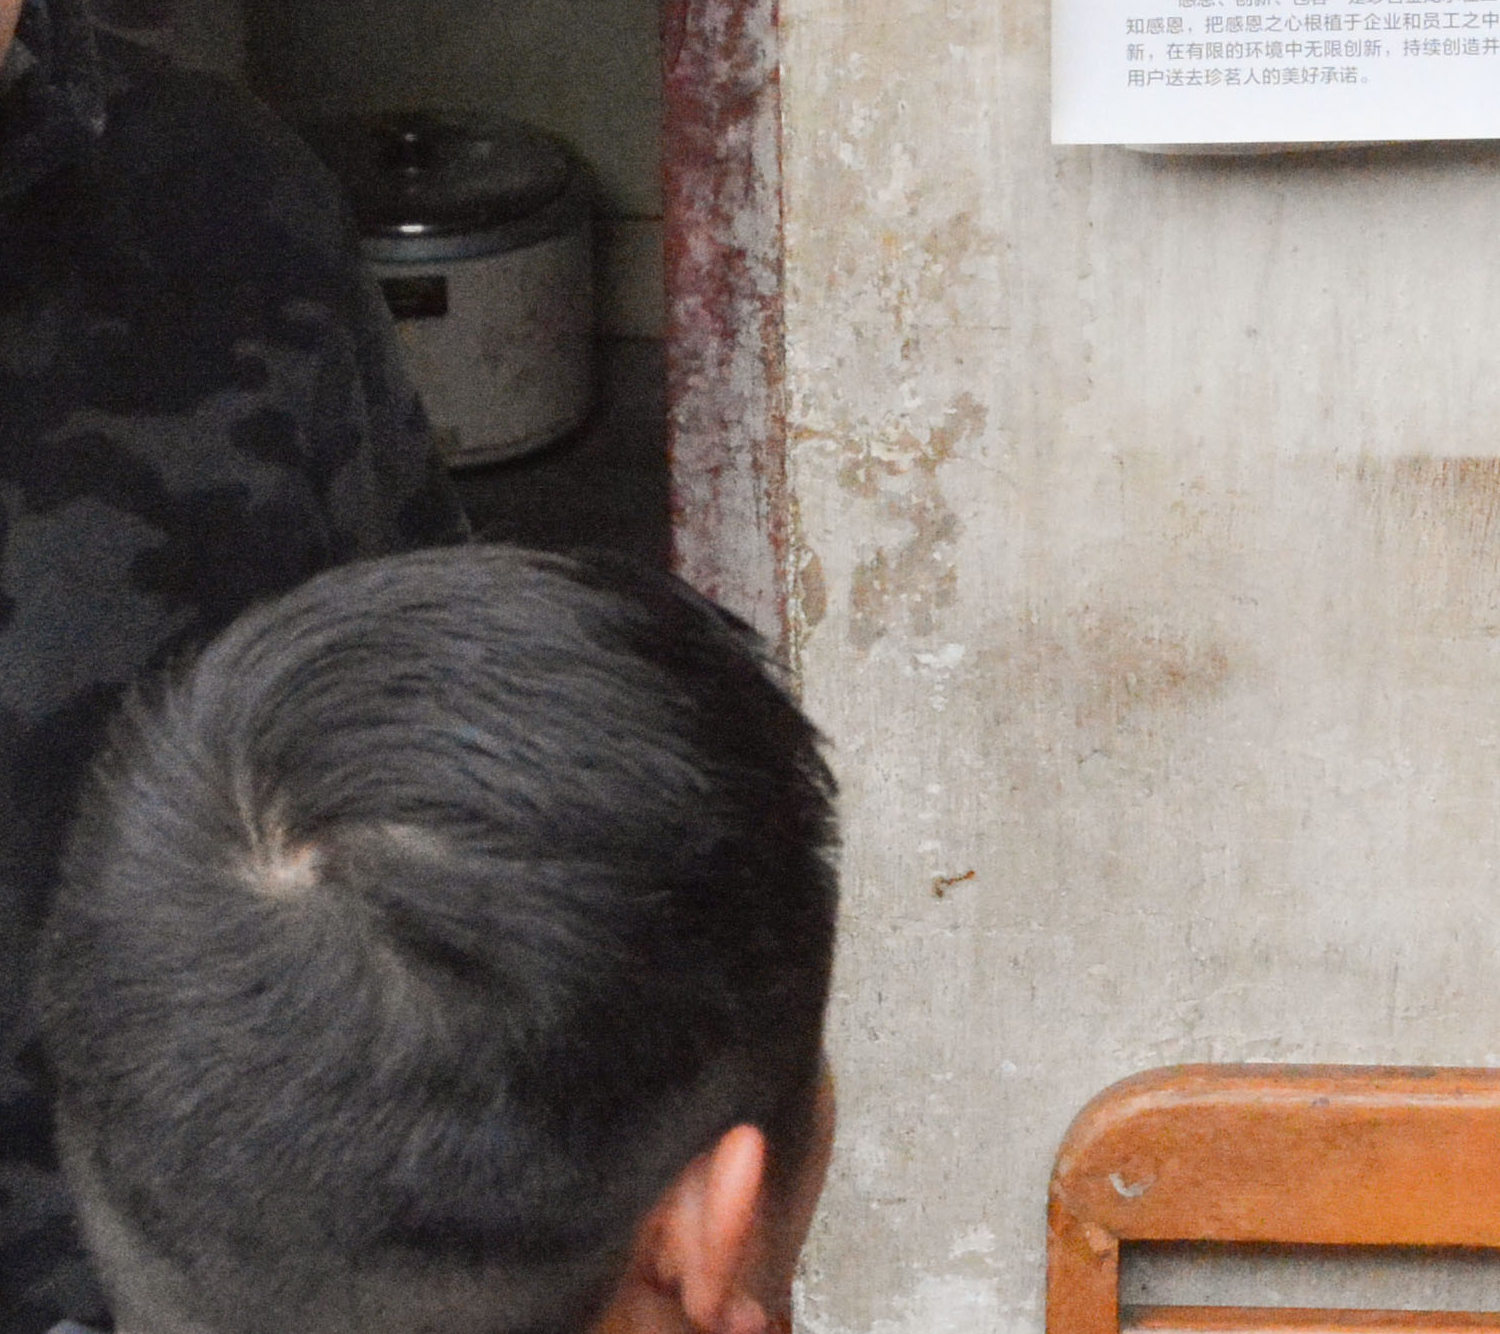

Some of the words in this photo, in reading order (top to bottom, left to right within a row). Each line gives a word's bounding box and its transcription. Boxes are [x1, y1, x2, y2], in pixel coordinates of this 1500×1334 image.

[1127, 66, 1371, 88] 用户送去珍茗人的美好承诺。
